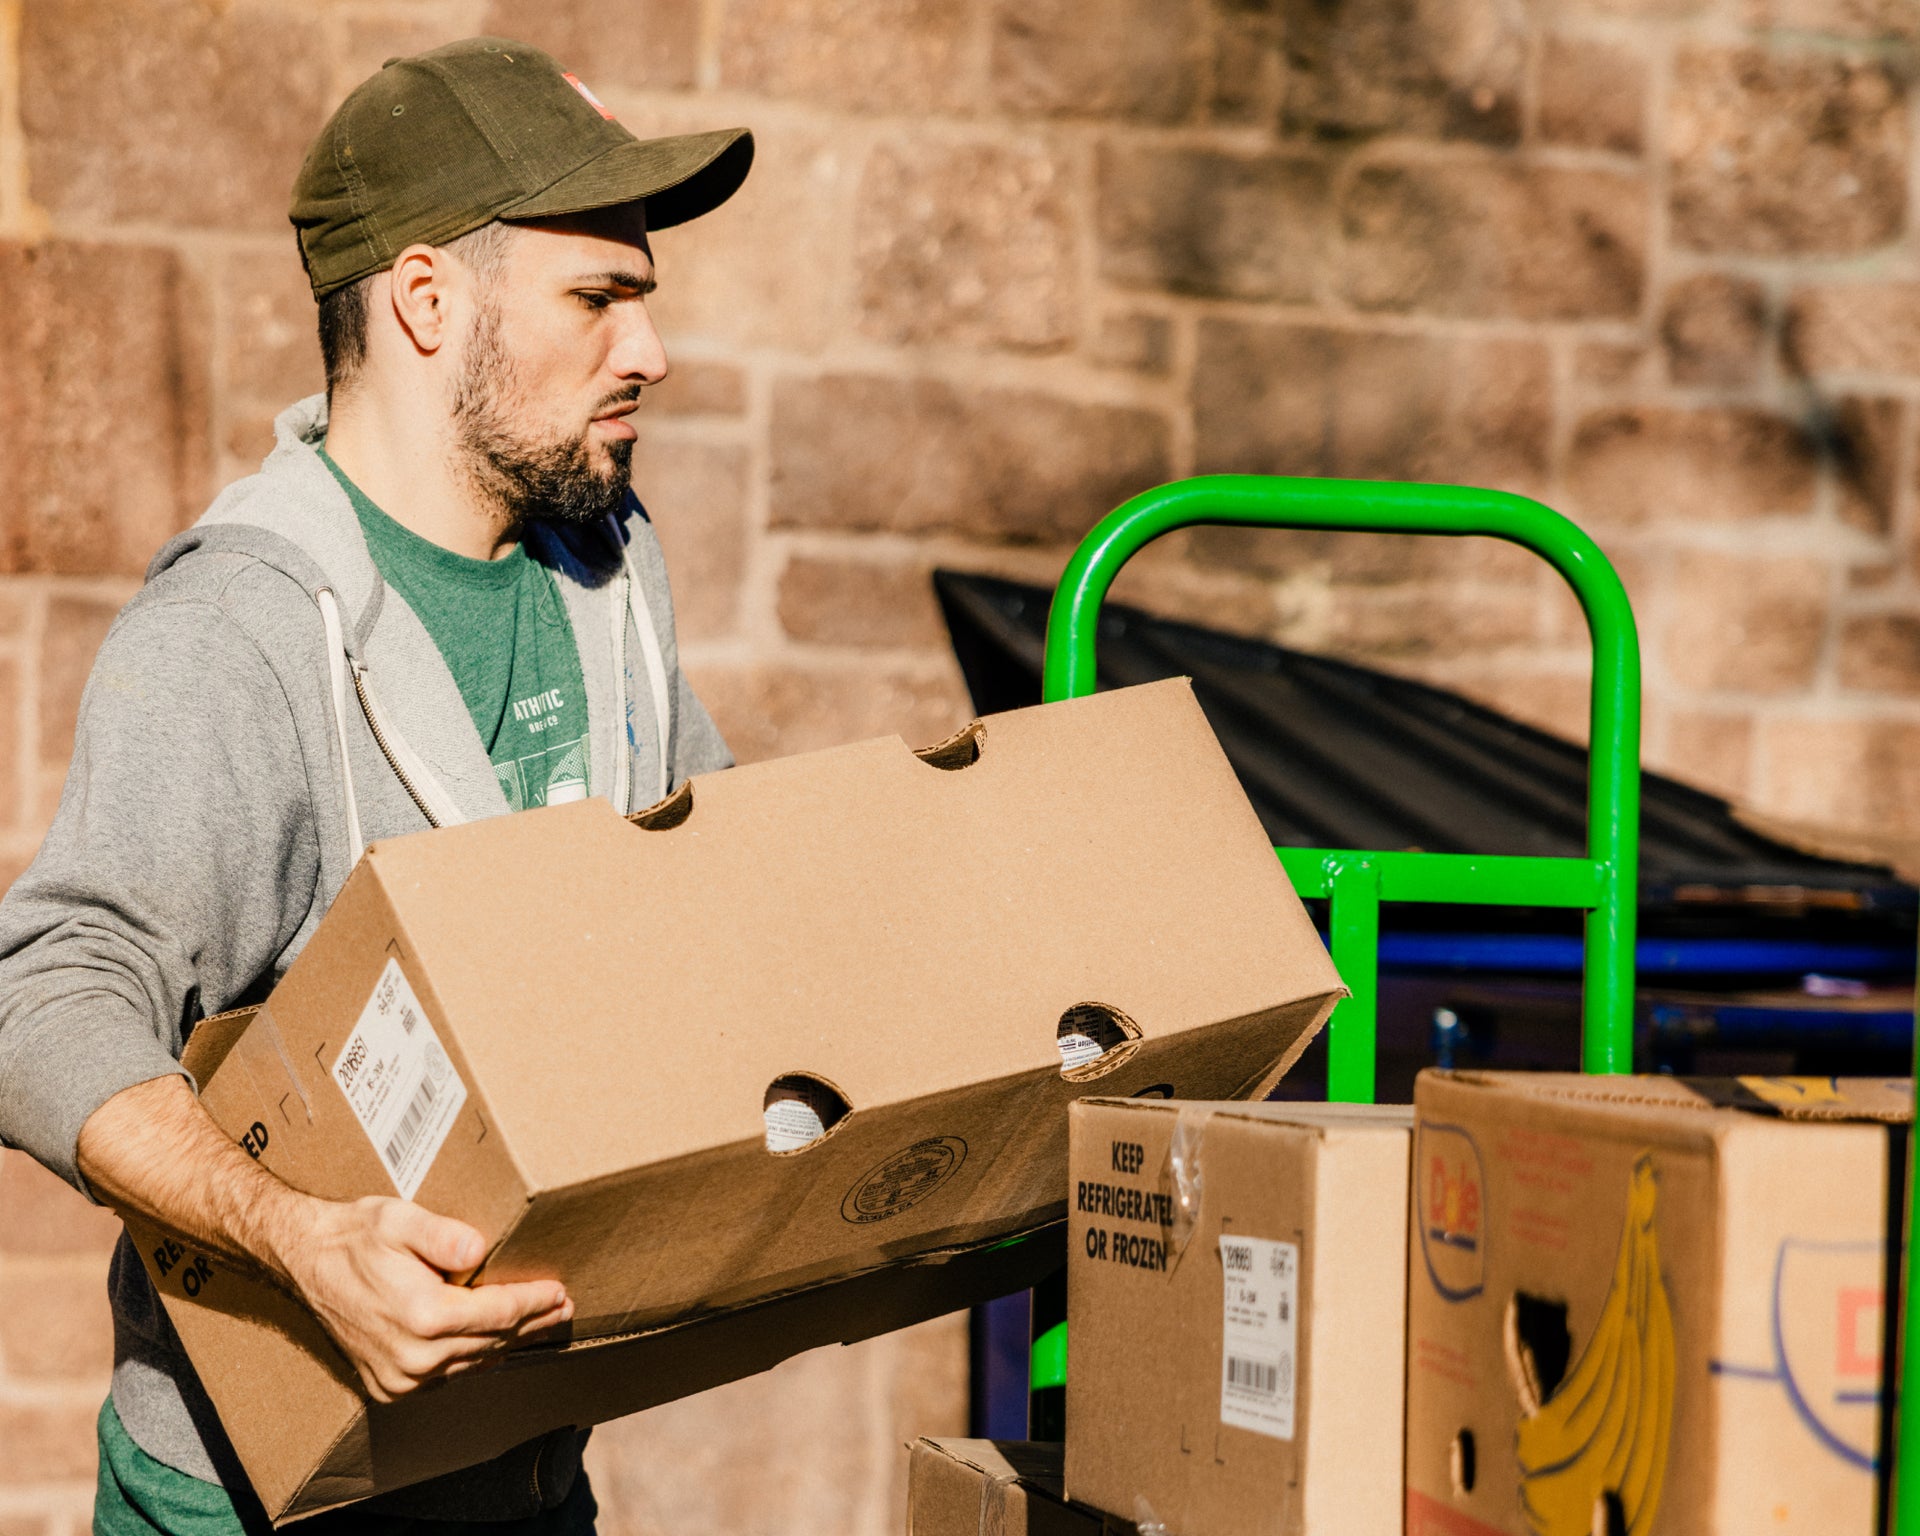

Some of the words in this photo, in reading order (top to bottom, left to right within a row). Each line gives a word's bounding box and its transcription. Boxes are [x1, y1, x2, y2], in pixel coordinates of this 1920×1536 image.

[338, 1034, 369, 1089] 2016651
[1112, 1141, 1144, 1175] KEEP
[1086, 1227, 1107, 1260] OR
[1113, 1232, 1167, 1272] FROZEN
[183, 1254, 215, 1297] OR
